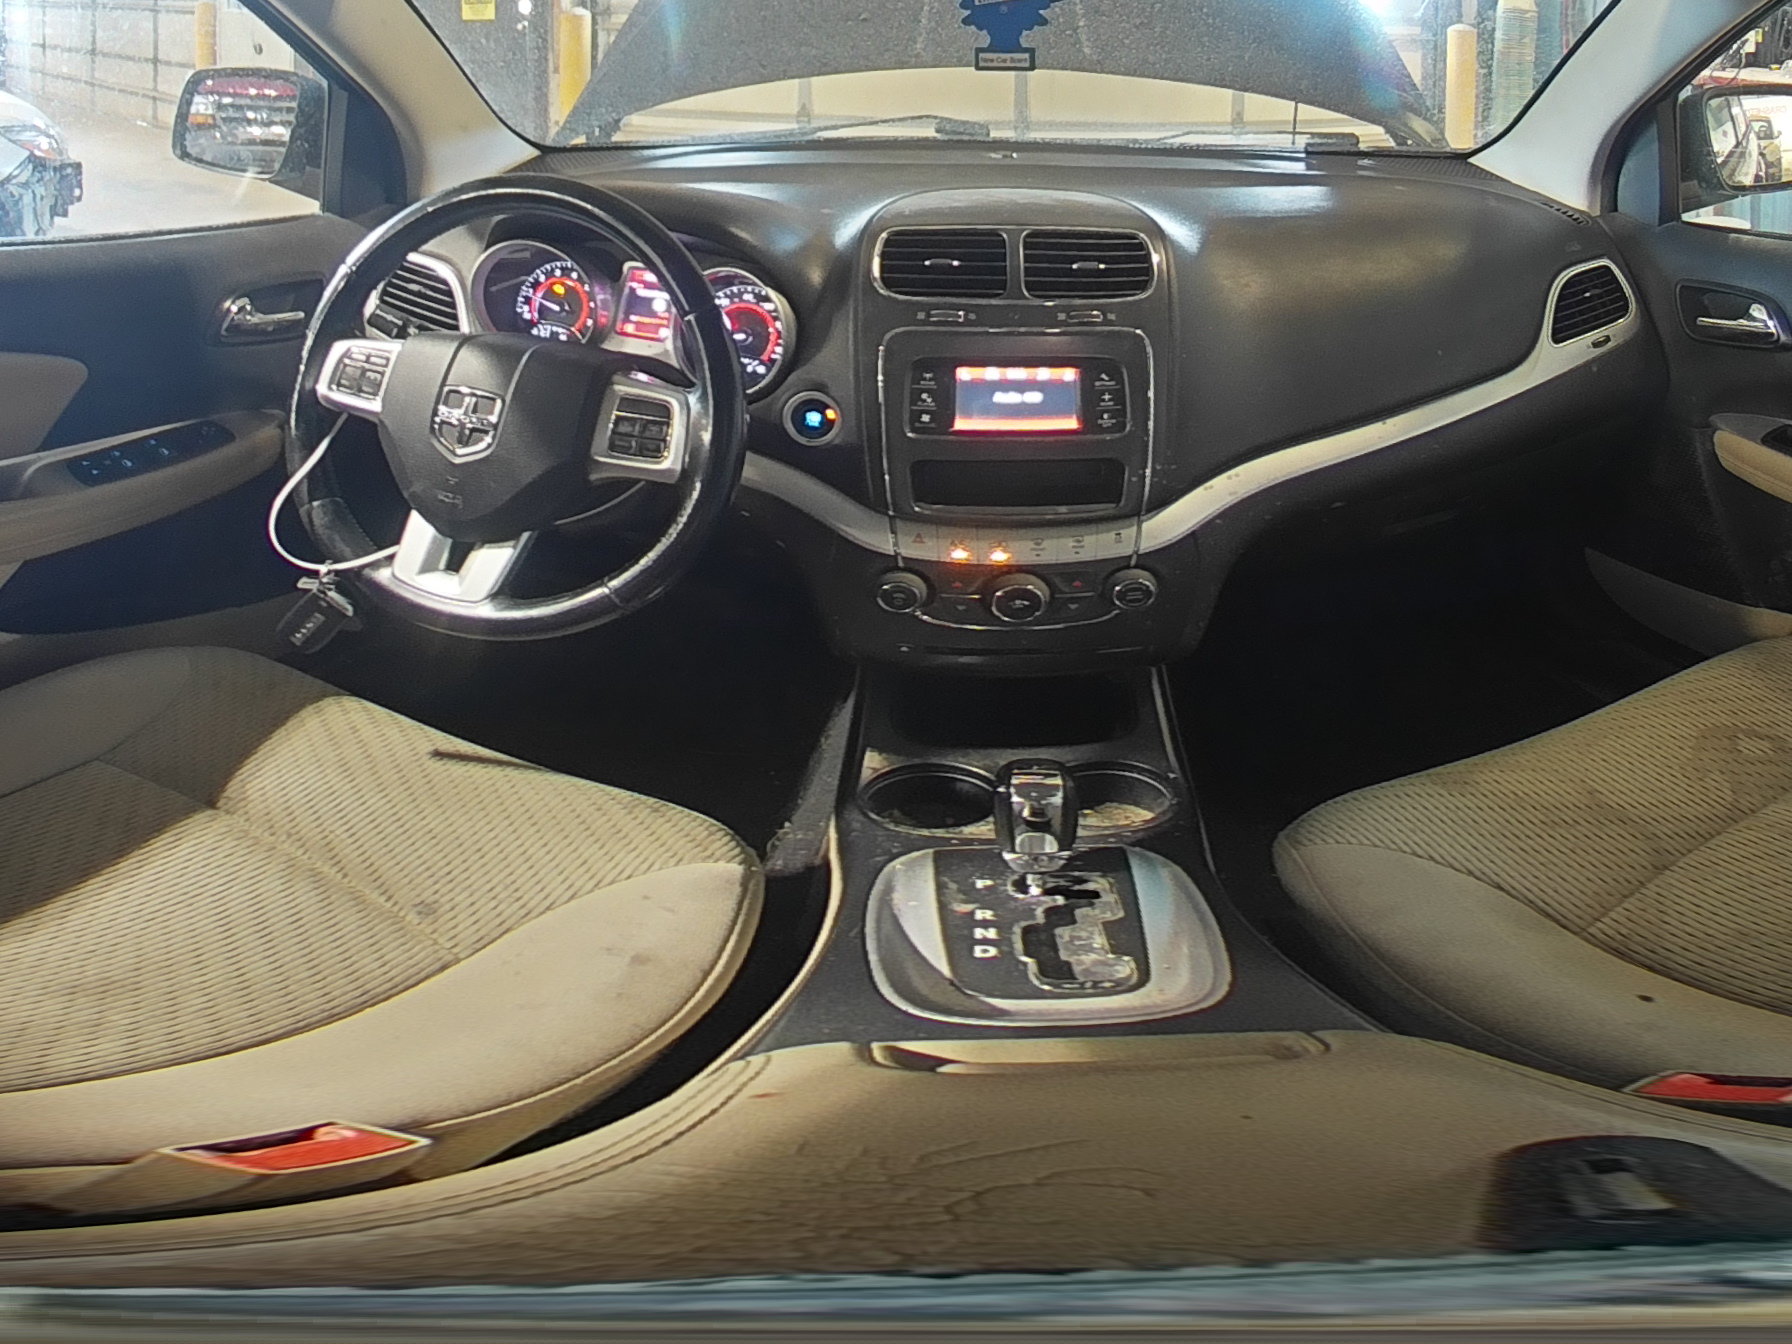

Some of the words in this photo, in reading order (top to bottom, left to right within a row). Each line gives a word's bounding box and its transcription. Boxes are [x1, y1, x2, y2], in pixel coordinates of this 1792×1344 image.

[975, 879, 995, 889] P
[974, 909, 997, 921] R
[973, 927, 1001, 940] N
[973, 944, 999, 959] D
